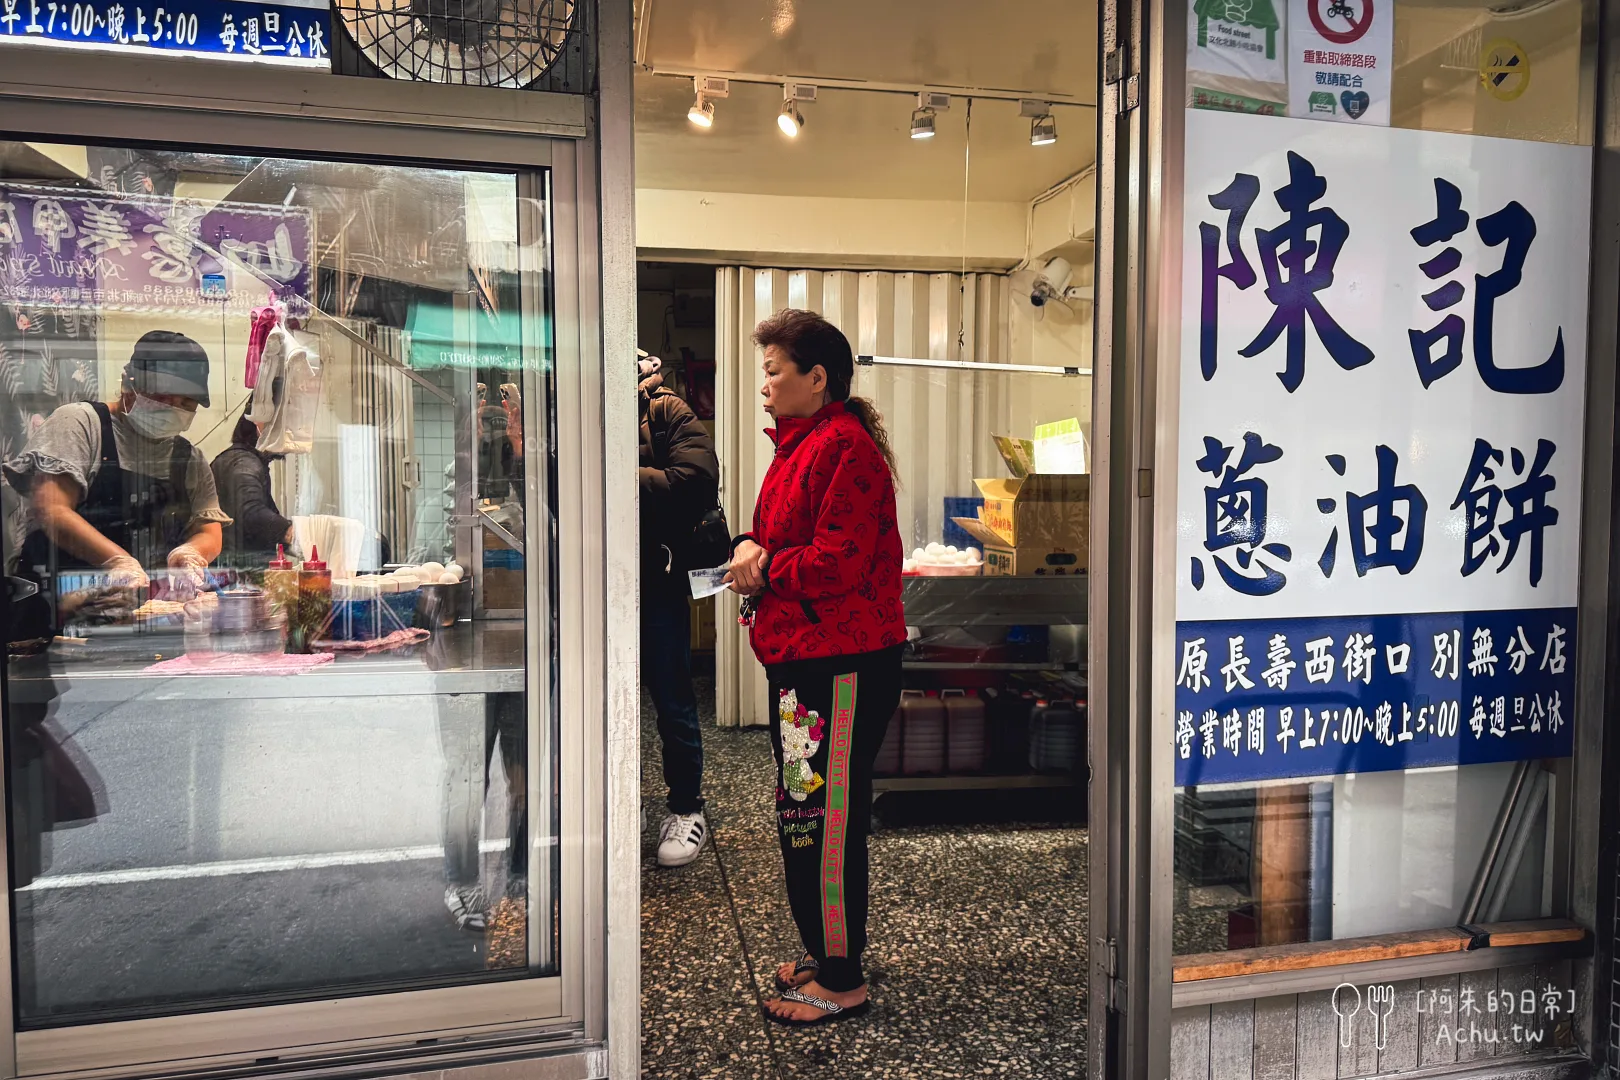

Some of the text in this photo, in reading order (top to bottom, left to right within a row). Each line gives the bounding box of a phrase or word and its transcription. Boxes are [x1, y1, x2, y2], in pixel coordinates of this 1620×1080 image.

[1217, 24, 1251, 39] Food street
[1303, 50, 1377, 69] 重點取締路段
[1315, 71, 1363, 88] 敬請配合
[1199, 150, 1565, 394] 陳記
[1190, 431, 1560, 597] 蔥油餅
[1176, 623, 1567, 694] 原長壽西街口 別無分店
[832, 709, 850, 787] HELLO KITTY
[1176, 707, 1265, 760] 營業時間
[1276, 700, 1459, 755] 早上7:00~晚上5:00
[791, 834, 814, 848] book
[827, 808, 842, 883] HELLO KITTY
[828, 905, 841, 942] HELLO
